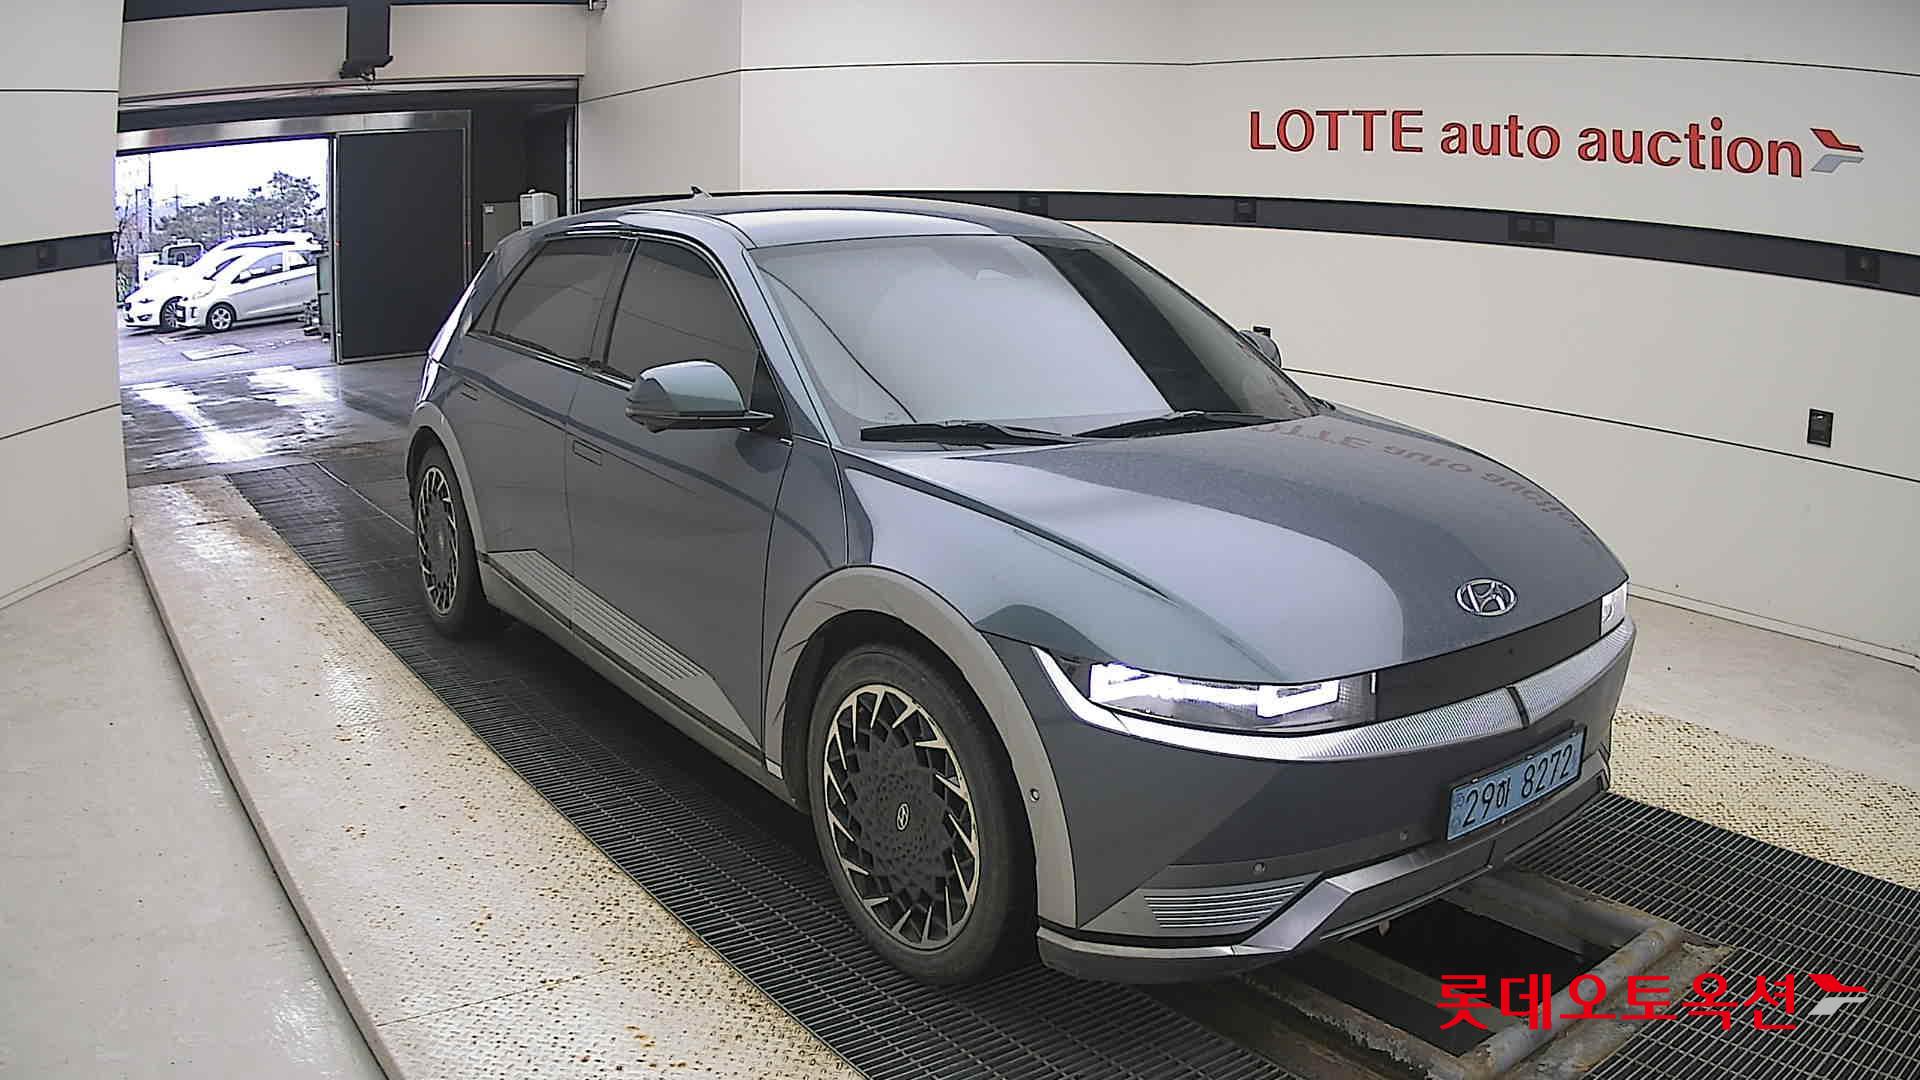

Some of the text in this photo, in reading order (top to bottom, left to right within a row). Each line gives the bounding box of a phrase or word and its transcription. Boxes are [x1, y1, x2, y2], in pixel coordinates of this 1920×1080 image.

[1249, 109, 1802, 178] LOTTE auto auction
[1521, 744, 1573, 798] 8272
